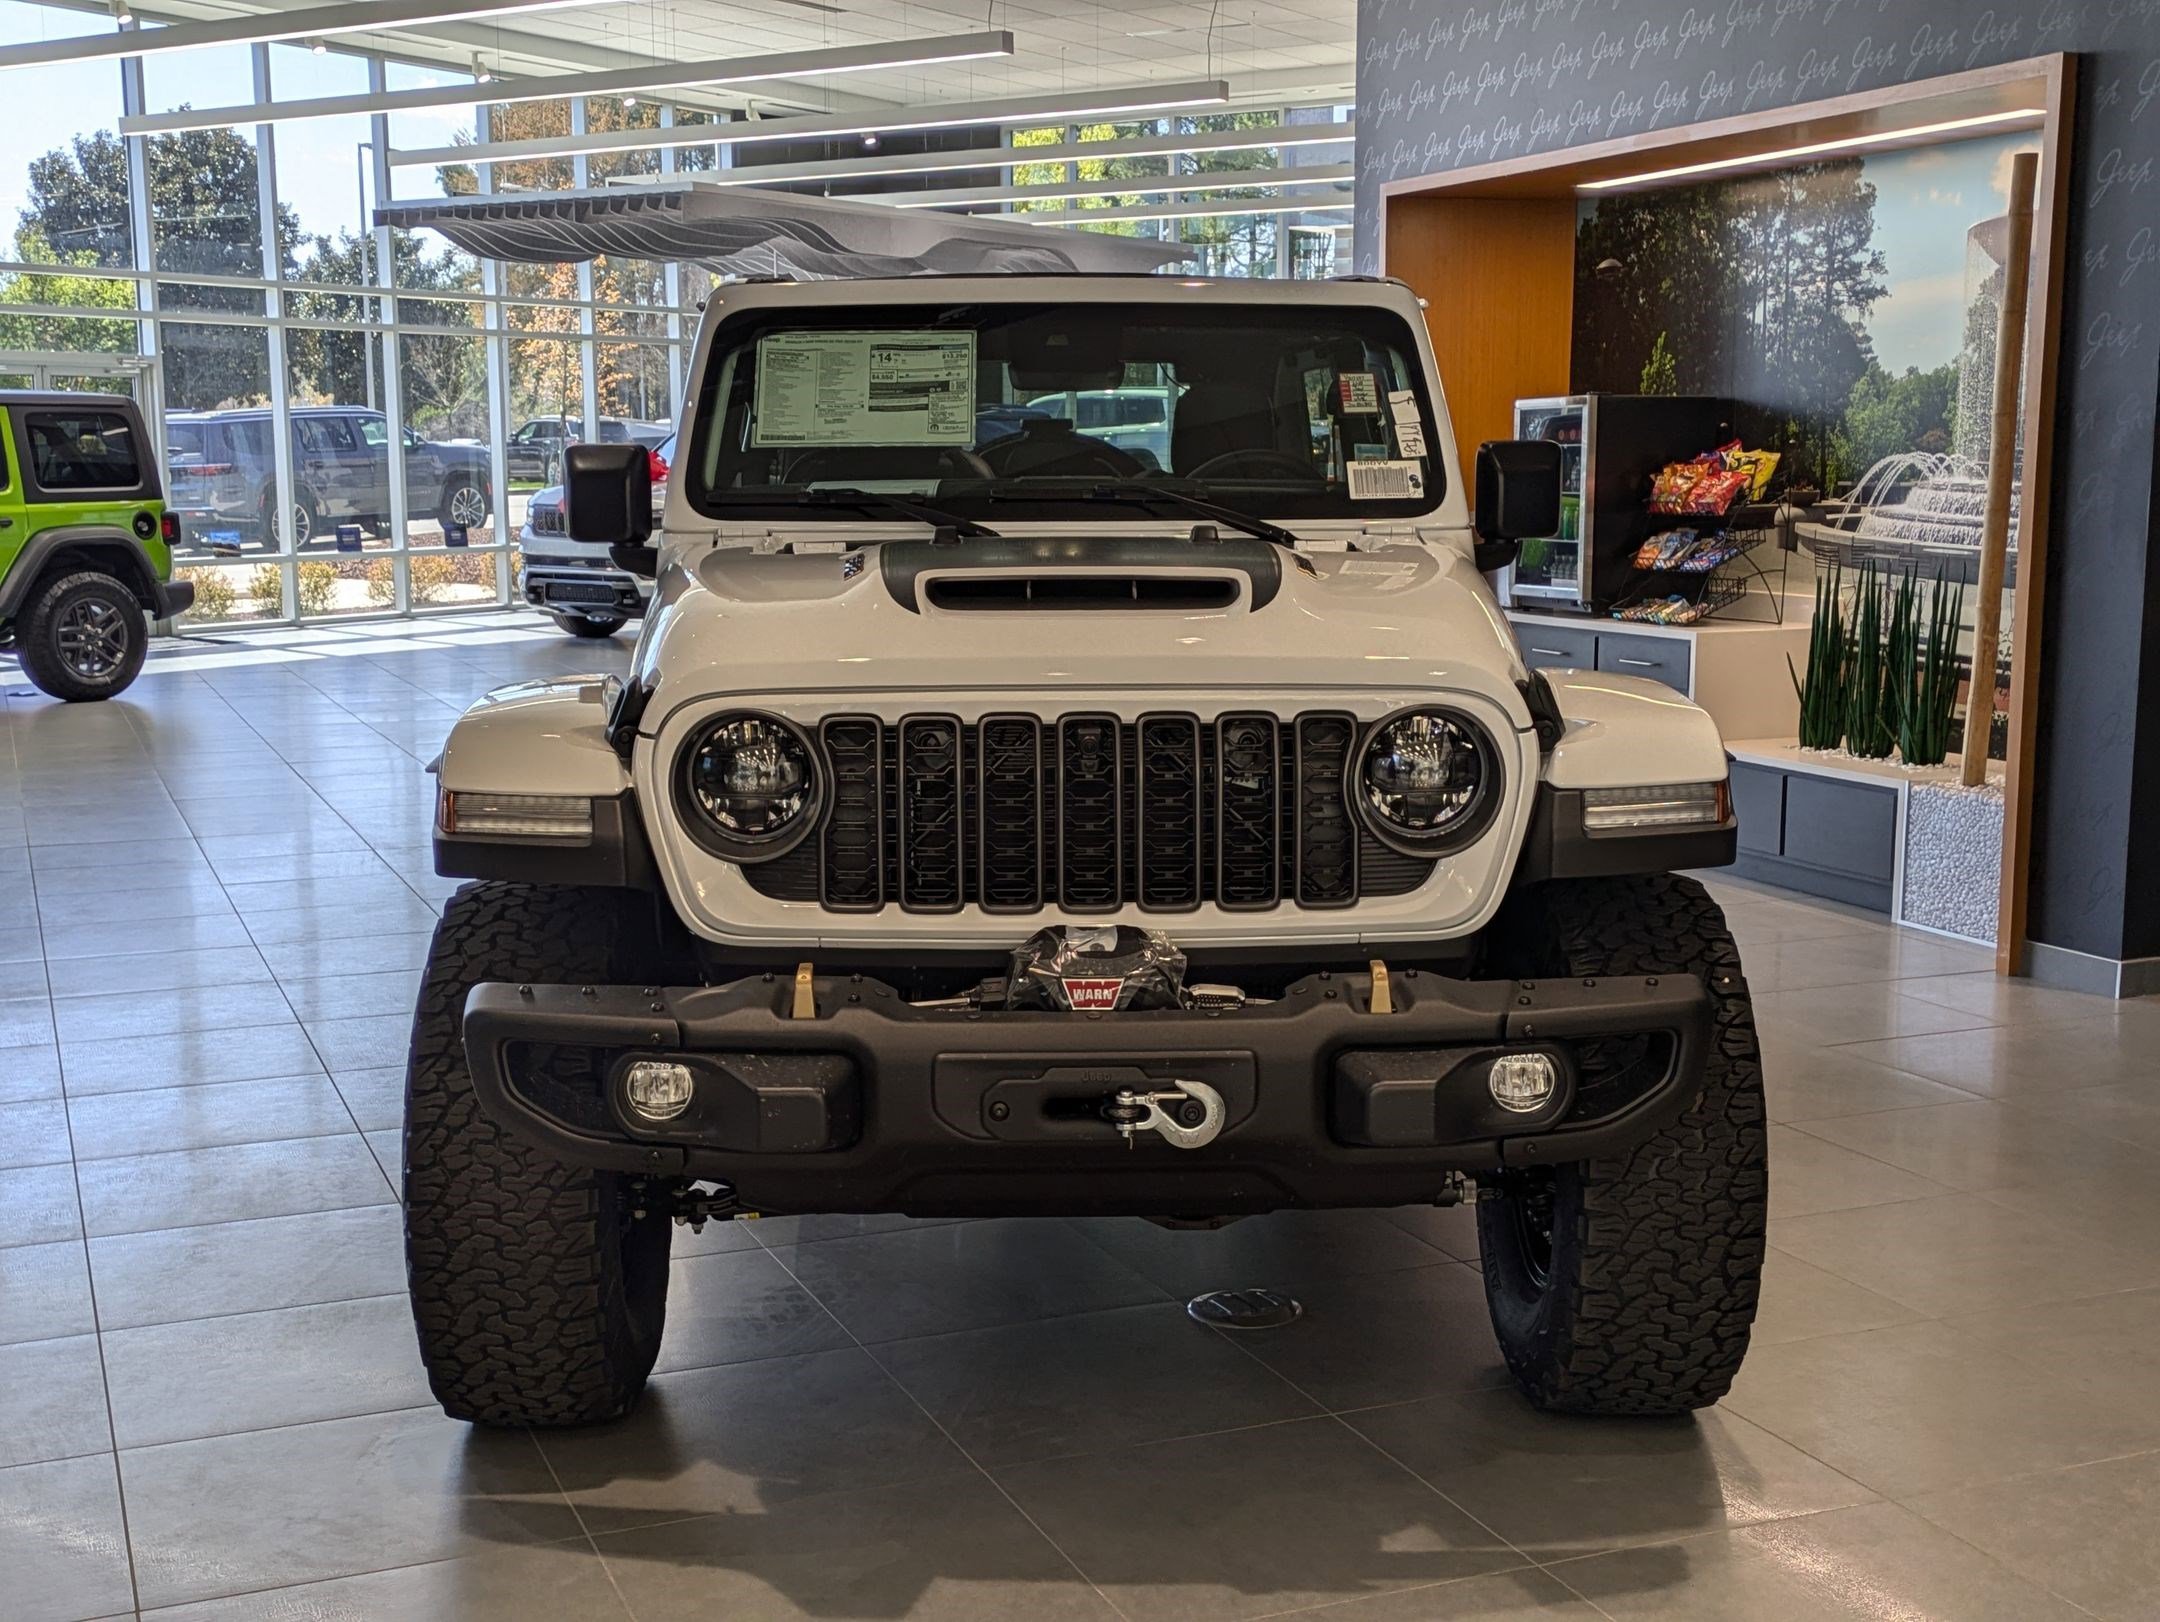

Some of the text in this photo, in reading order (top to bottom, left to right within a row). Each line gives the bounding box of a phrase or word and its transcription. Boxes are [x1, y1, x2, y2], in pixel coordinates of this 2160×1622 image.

[1362, 37, 1389, 78] Jeep
[1392, 28, 1421, 71] Jeep
[1424, 17, 1455, 61] Jeep
[1459, 8, 1490, 52] Jeep
[1494, 0, 1527, 42] Jeep
[1376, 87, 1403, 128] Jeep
[1407, 80, 1435, 122] Jeep
[1440, 71, 1470, 114] Jeep
[1474, 61, 1506, 105] Jeep
[1510, 52, 1544, 97] Jeep
[1548, 42, 1583, 88] Jeep
[1587, 31, 1625, 80] Jeep
[1630, 20, 1669, 70] Jeep
[1674, 8, 1716, 59] Jeep
[1721, 0, 1765, 48] Jeep
[1361, 146, 1387, 185] Jeep
[1390, 138, 1418, 180] Jeep
[1420, 131, 1451, 174] Jeep
[1454, 124, 1486, 168] Jeep
[1489, 115, 1521, 160] Jeep
[1526, 108, 1560, 153] Jeep
[1565, 99, 1601, 146] Jeep
[1605, 90, 1644, 138] Jeep
[1649, 80, 1689, 129] Jeep
[1695, 70, 1736, 120] Jeep
[1741, 60, 1787, 111] Jeep
[1792, 48, 1840, 102] Jeep
[1846, 36, 1897, 92] Jeep
[1904, 23, 1958, 80] Jeep
[1965, 9, 2025, 68] Jeep
[2089, 148, 2155, 208] Jeep
[878, 352, 892, 363] 14
[2079, 312, 2143, 370] Jeep
[1073, 988, 1113, 1001] WARN
